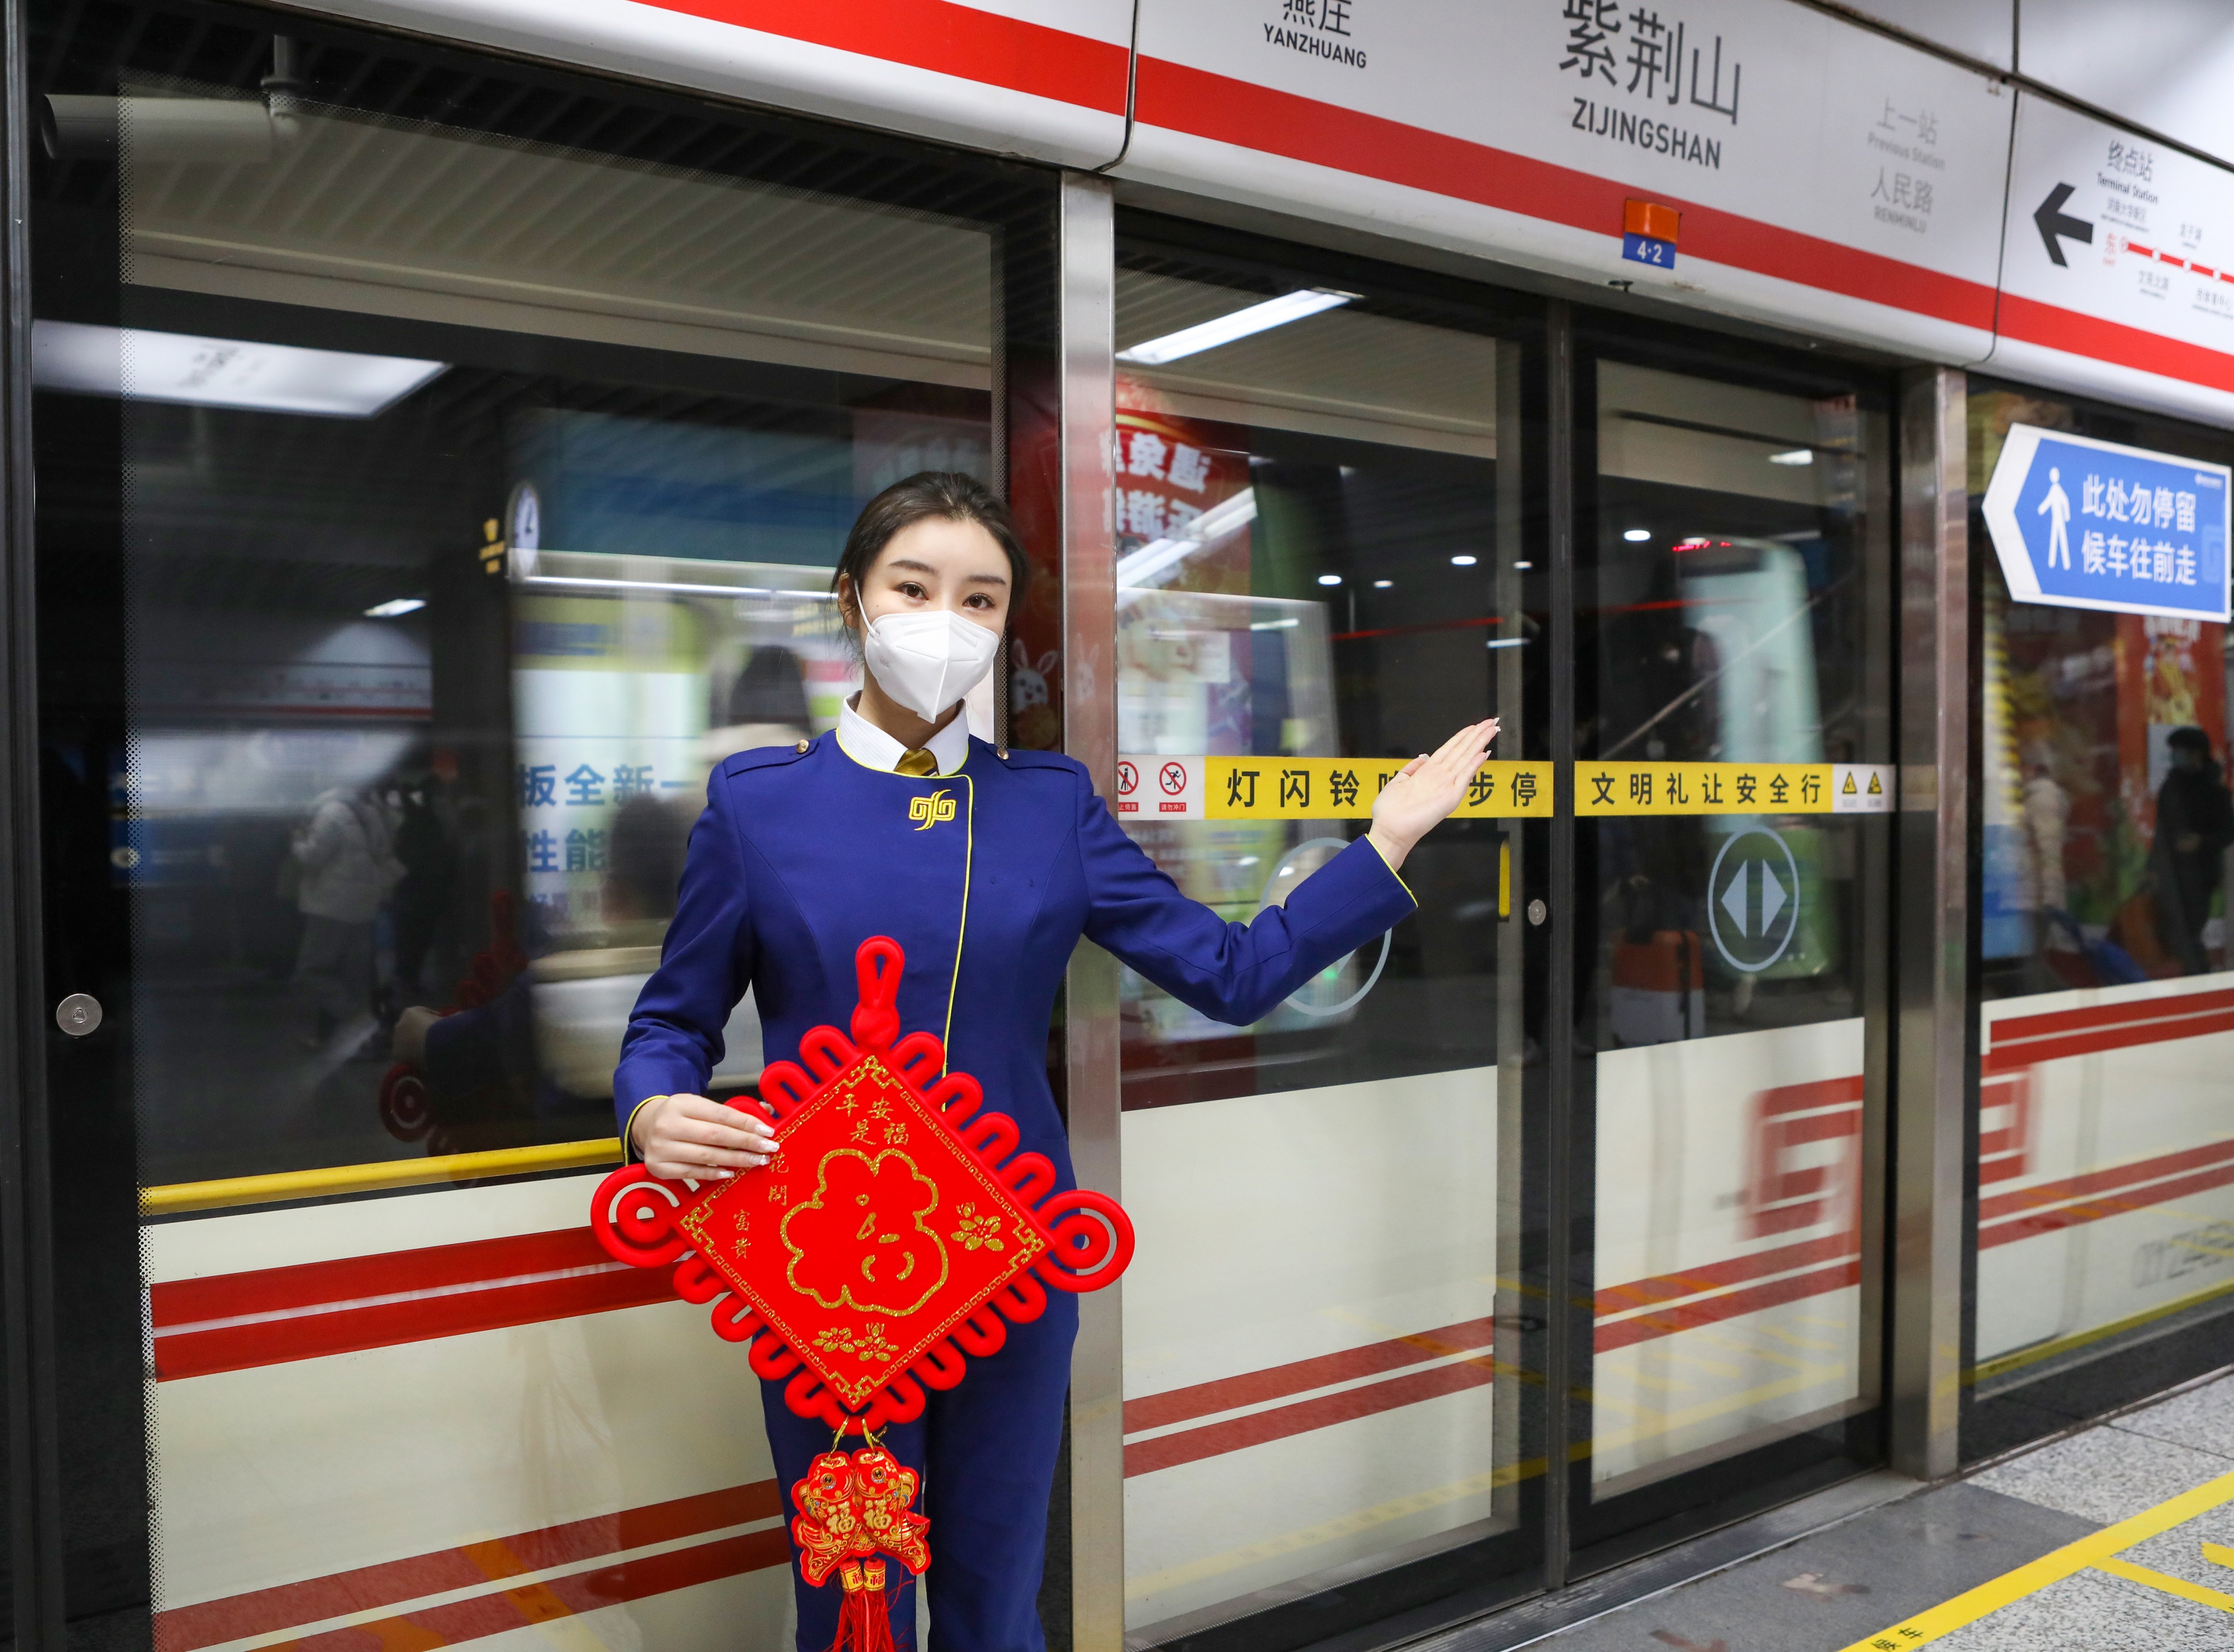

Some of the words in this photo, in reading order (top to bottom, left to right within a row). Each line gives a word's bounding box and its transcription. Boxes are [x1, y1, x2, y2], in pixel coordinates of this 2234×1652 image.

[1264, 23, 1366, 68] YANZHUANG
[1559, 0, 1740, 125] 紫荆山
[1572, 97, 1721, 170] ZIJINGSHAN
[1876, 97, 1938, 145] 上一站
[2107, 140, 2154, 183] 终点站
[1871, 166, 1934, 215] 人民路
[2097, 172, 2130, 196] Terminal
[2132, 185, 2159, 205] Station
[2082, 474, 2196, 533] 此处勿停留
[2082, 530, 2197, 585] 候车往前走
[1227, 768, 1537, 808] 灯闪铃步停
[1591, 772, 1821, 805] 文明礼让安全行
